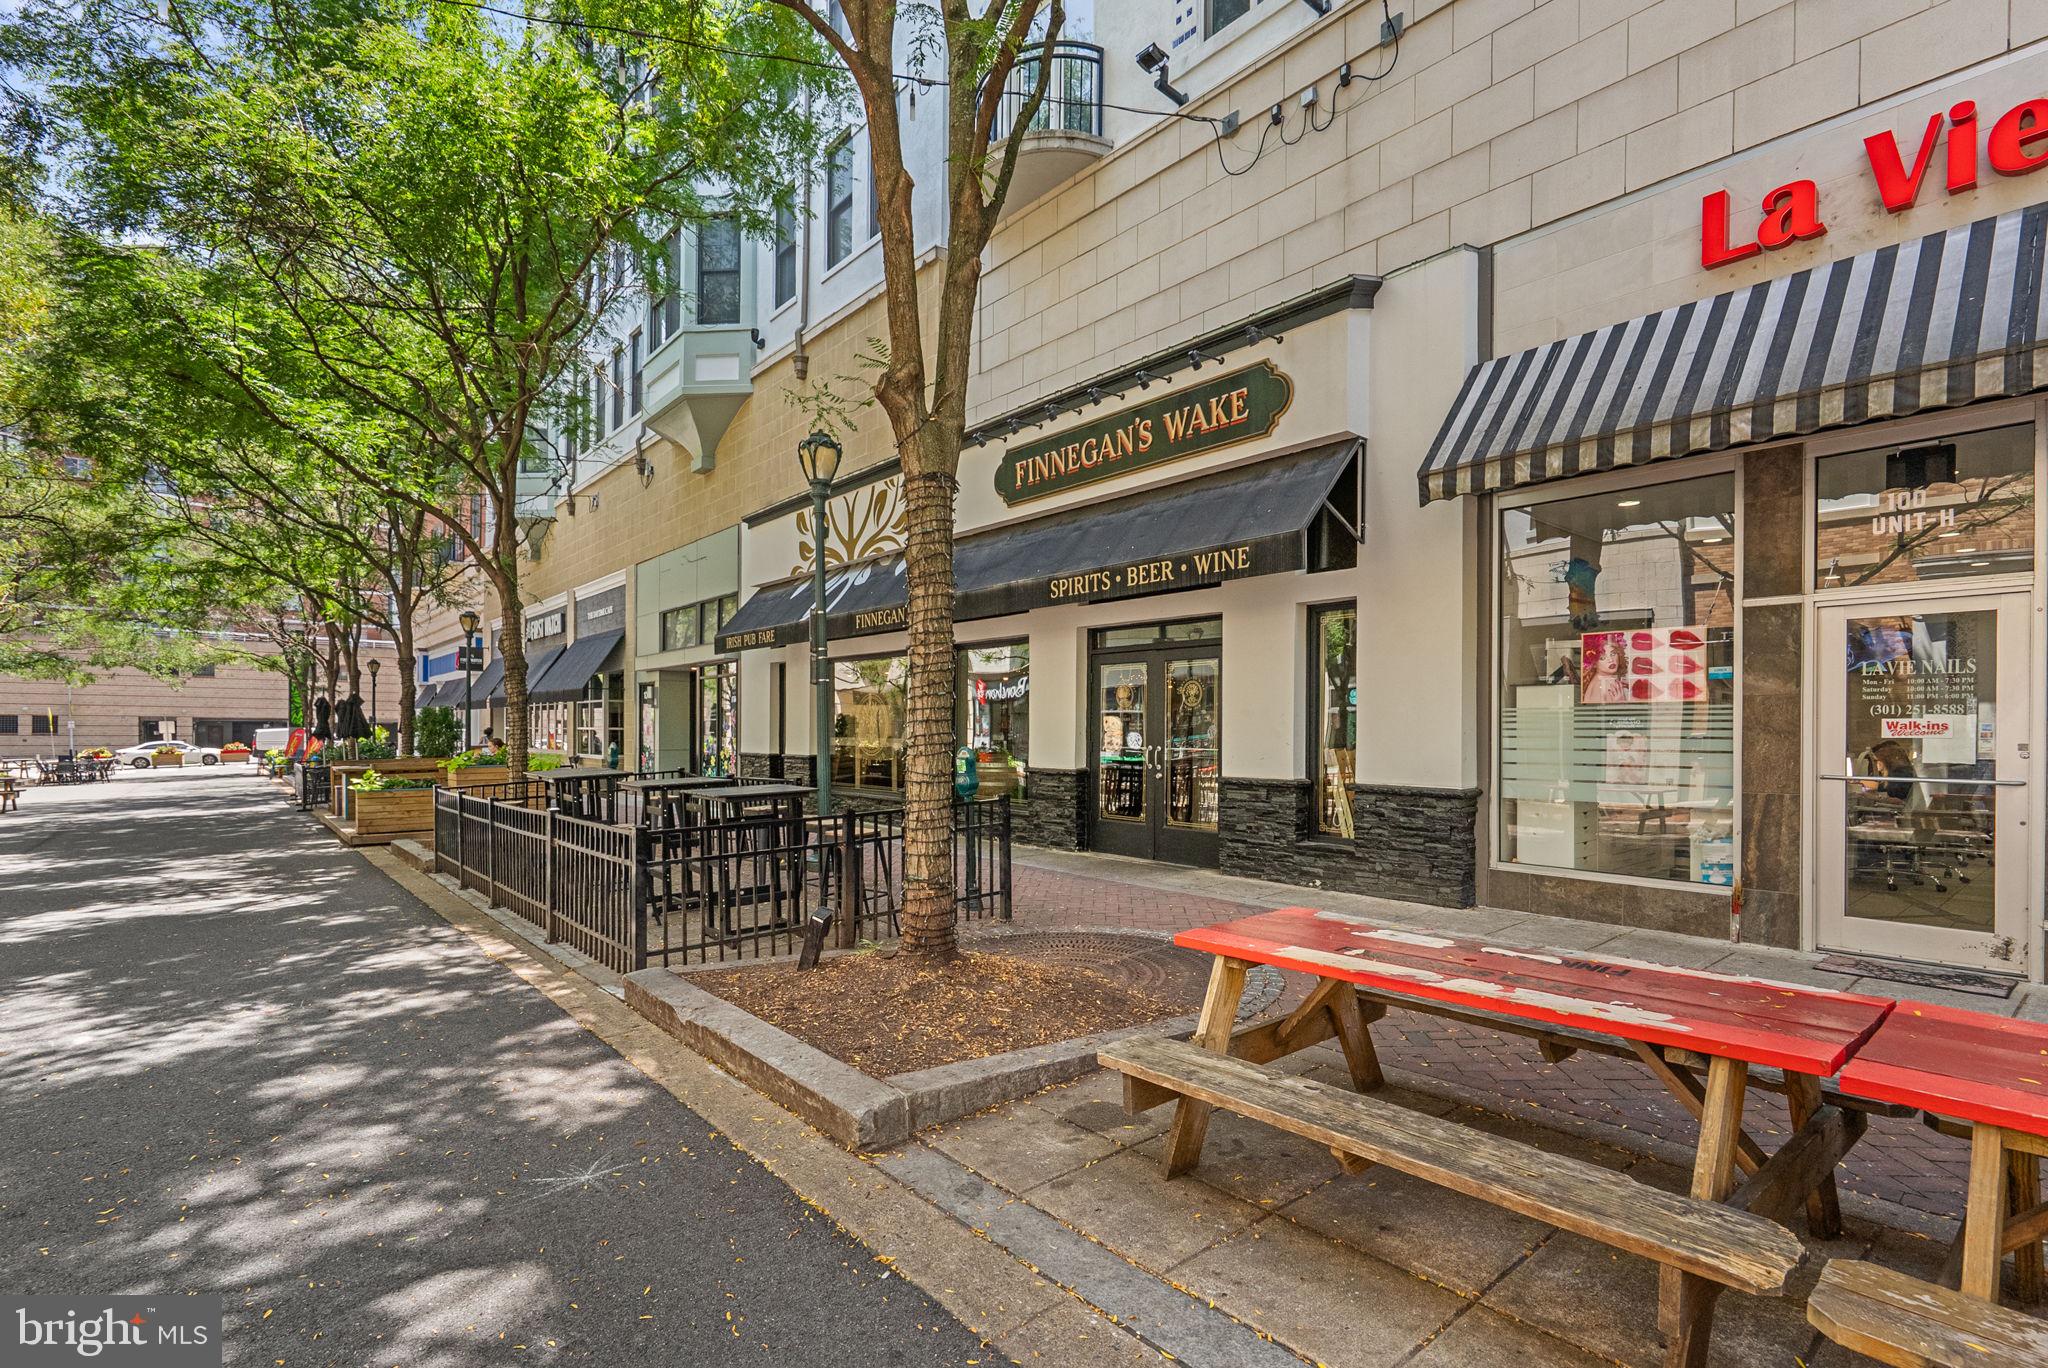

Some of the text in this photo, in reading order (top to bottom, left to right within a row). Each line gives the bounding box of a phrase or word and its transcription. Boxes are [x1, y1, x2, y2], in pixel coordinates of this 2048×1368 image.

[1702, 98, 2048, 271] La Vie
[1015, 388, 1249, 489] FINNEGAN'S WAKE
[1888, 489, 1927, 511] 100
[1872, 508, 1954, 535] UNIT-H
[1050, 546, 1250, 599] SPIRITS BEER WINE
[856, 607, 906, 629] FINNEGAN
[726, 630, 776, 649] IRISH PUB FARE
[1920, 658, 1977, 676] NAILS
[1870, 703, 1965, 717] (301) 251-8588
[1886, 721, 1949, 731] Walk-ins
[1889, 729, 1946, 737] Welcome
